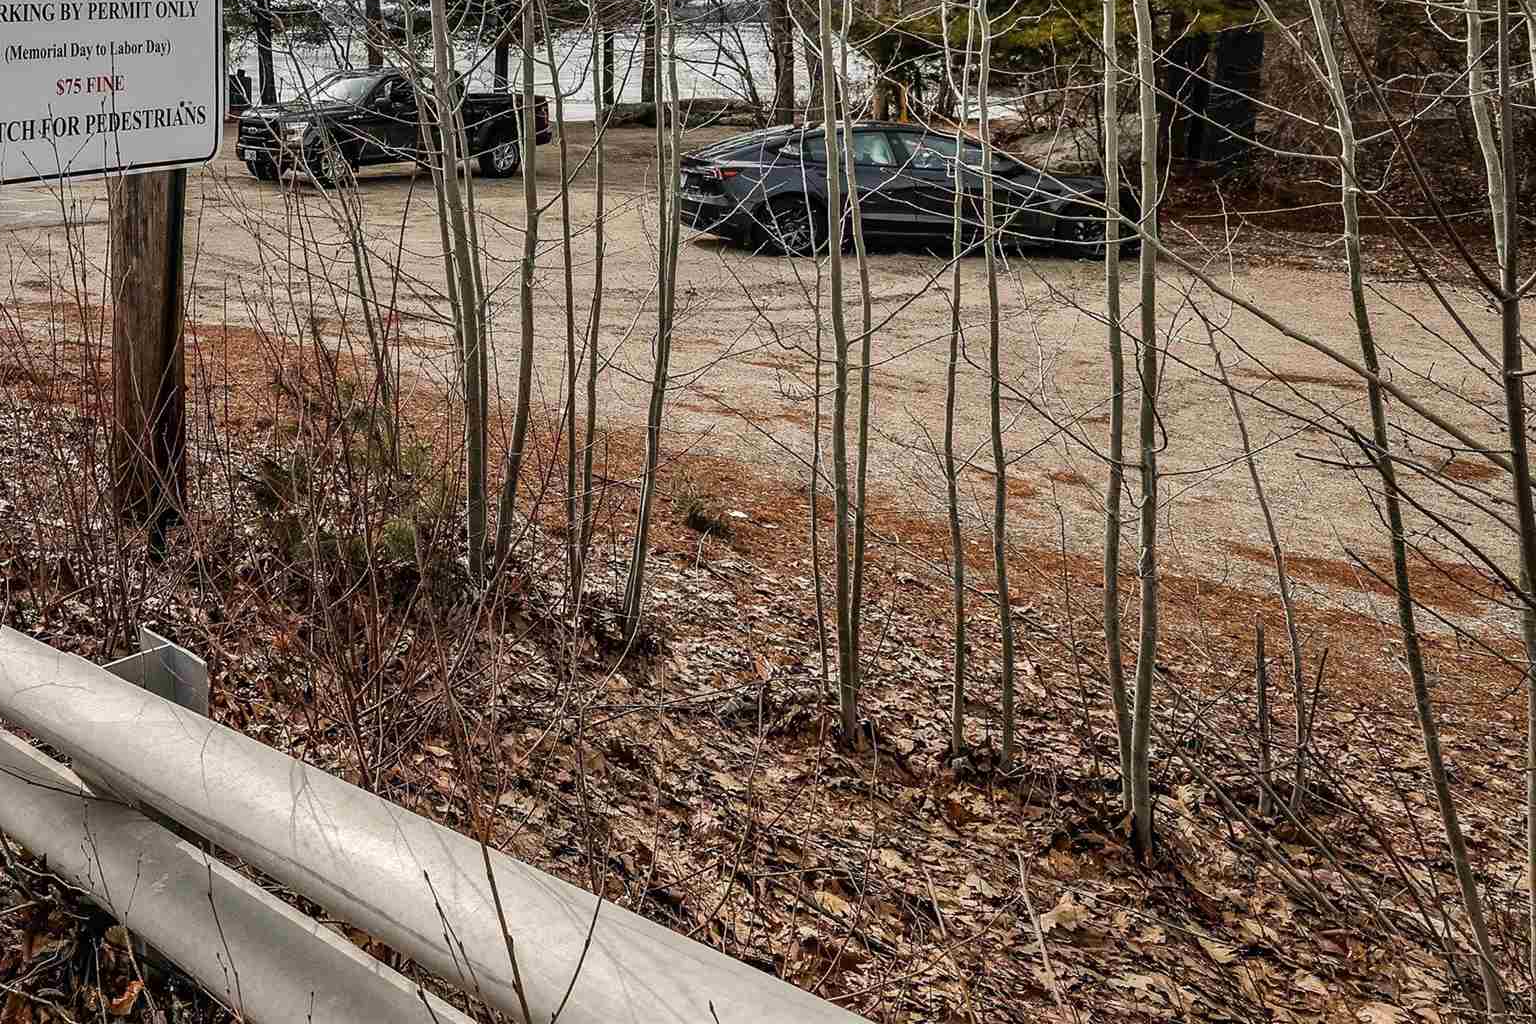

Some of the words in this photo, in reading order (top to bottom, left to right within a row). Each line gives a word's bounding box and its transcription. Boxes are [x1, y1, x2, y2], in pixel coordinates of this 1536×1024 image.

[60, 2, 84, 21] BY
[88, 1, 153, 20] PERMIT
[155, 0, 199, 19] ONLY
[4, 43, 67, 64] (Memorial
[70, 42, 93, 61] Day
[95, 42, 107, 56] to
[111, 40, 143, 57] Labor
[145, 39, 172, 57] Day)
[56, 78, 82, 96] $75
[86, 75, 125, 94] FINE
[41, 115, 81, 139] FOR
[85, 105, 207, 135] PEDESTRIANS
